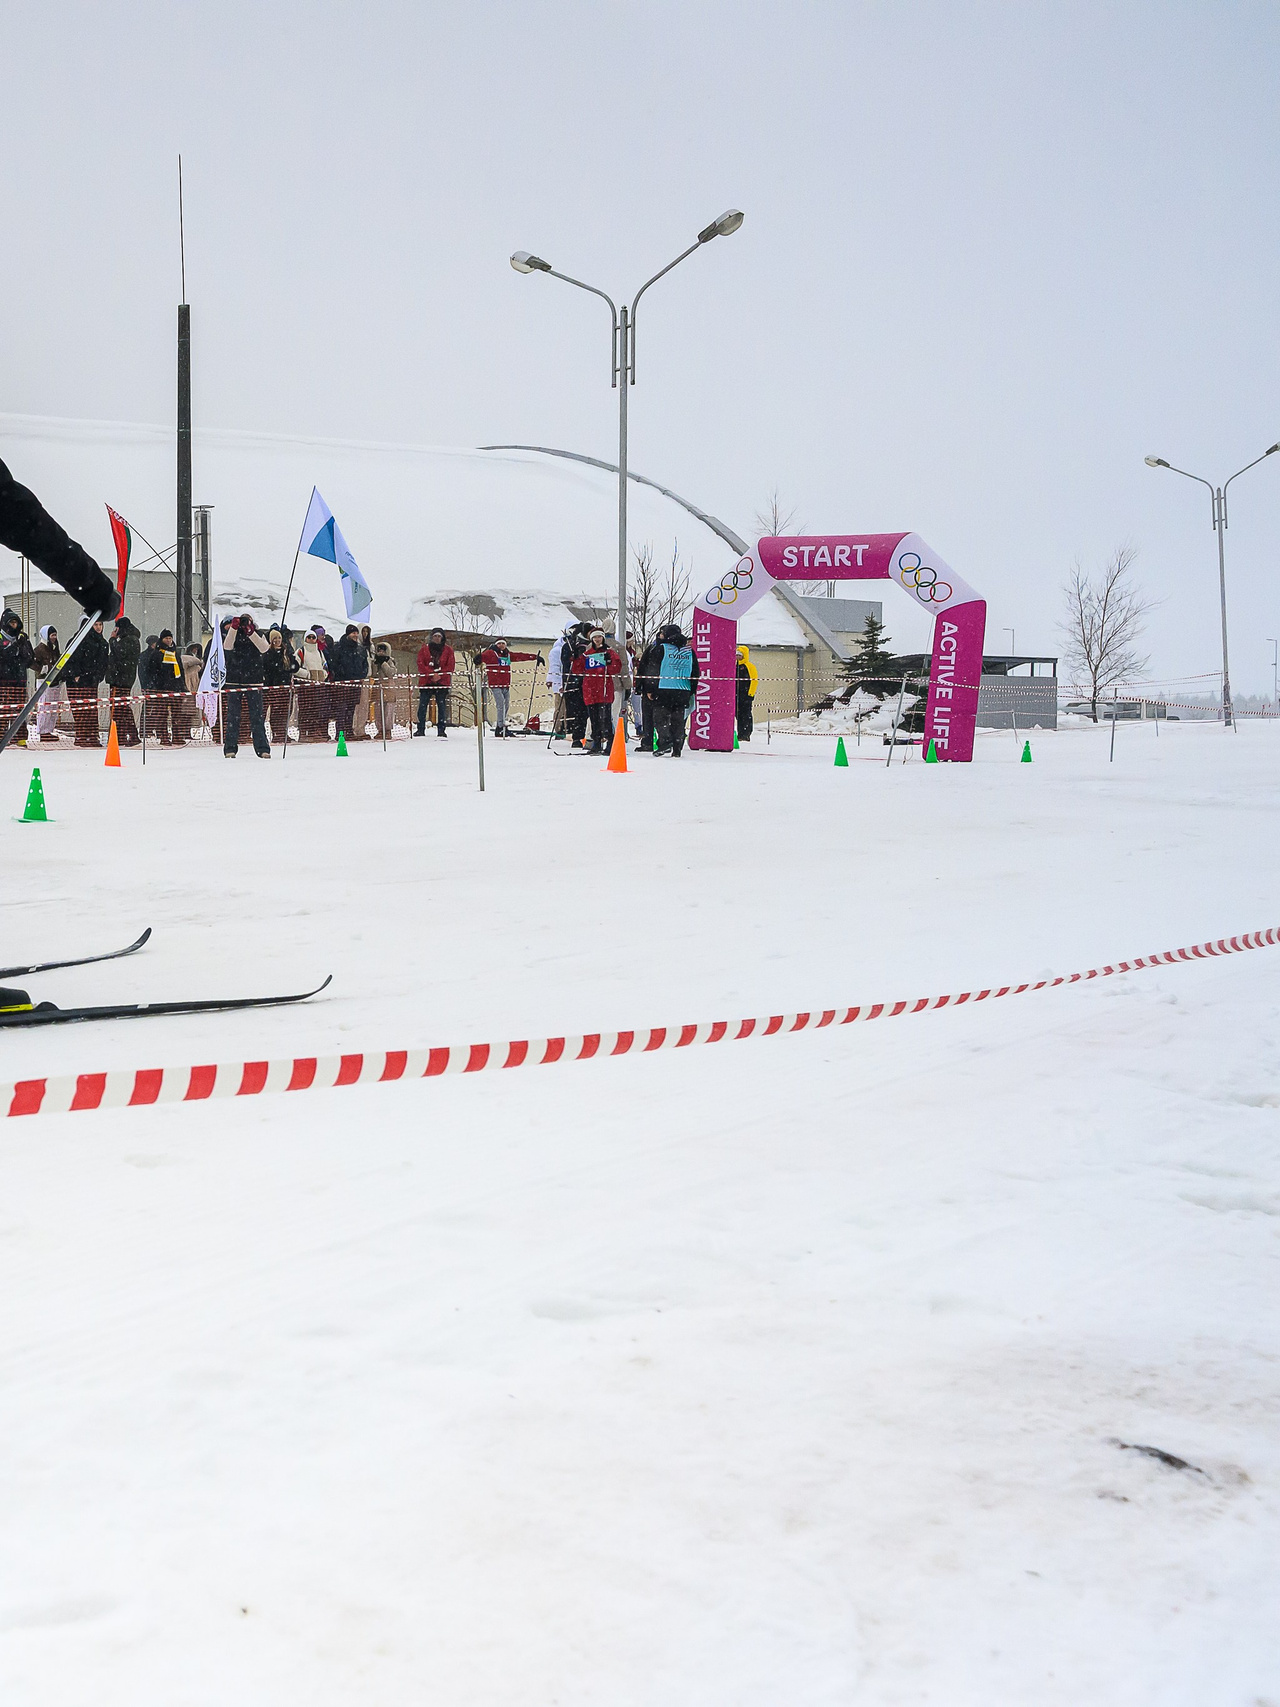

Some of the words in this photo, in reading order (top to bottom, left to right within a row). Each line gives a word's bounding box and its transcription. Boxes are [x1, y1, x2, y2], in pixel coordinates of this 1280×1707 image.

[782, 544, 869, 567] START
[697, 622, 711, 662] LIFE
[936, 621, 958, 699] ACTIVE
[696, 669, 711, 739] ACTIVE
[933, 706, 951, 750] LIFE
